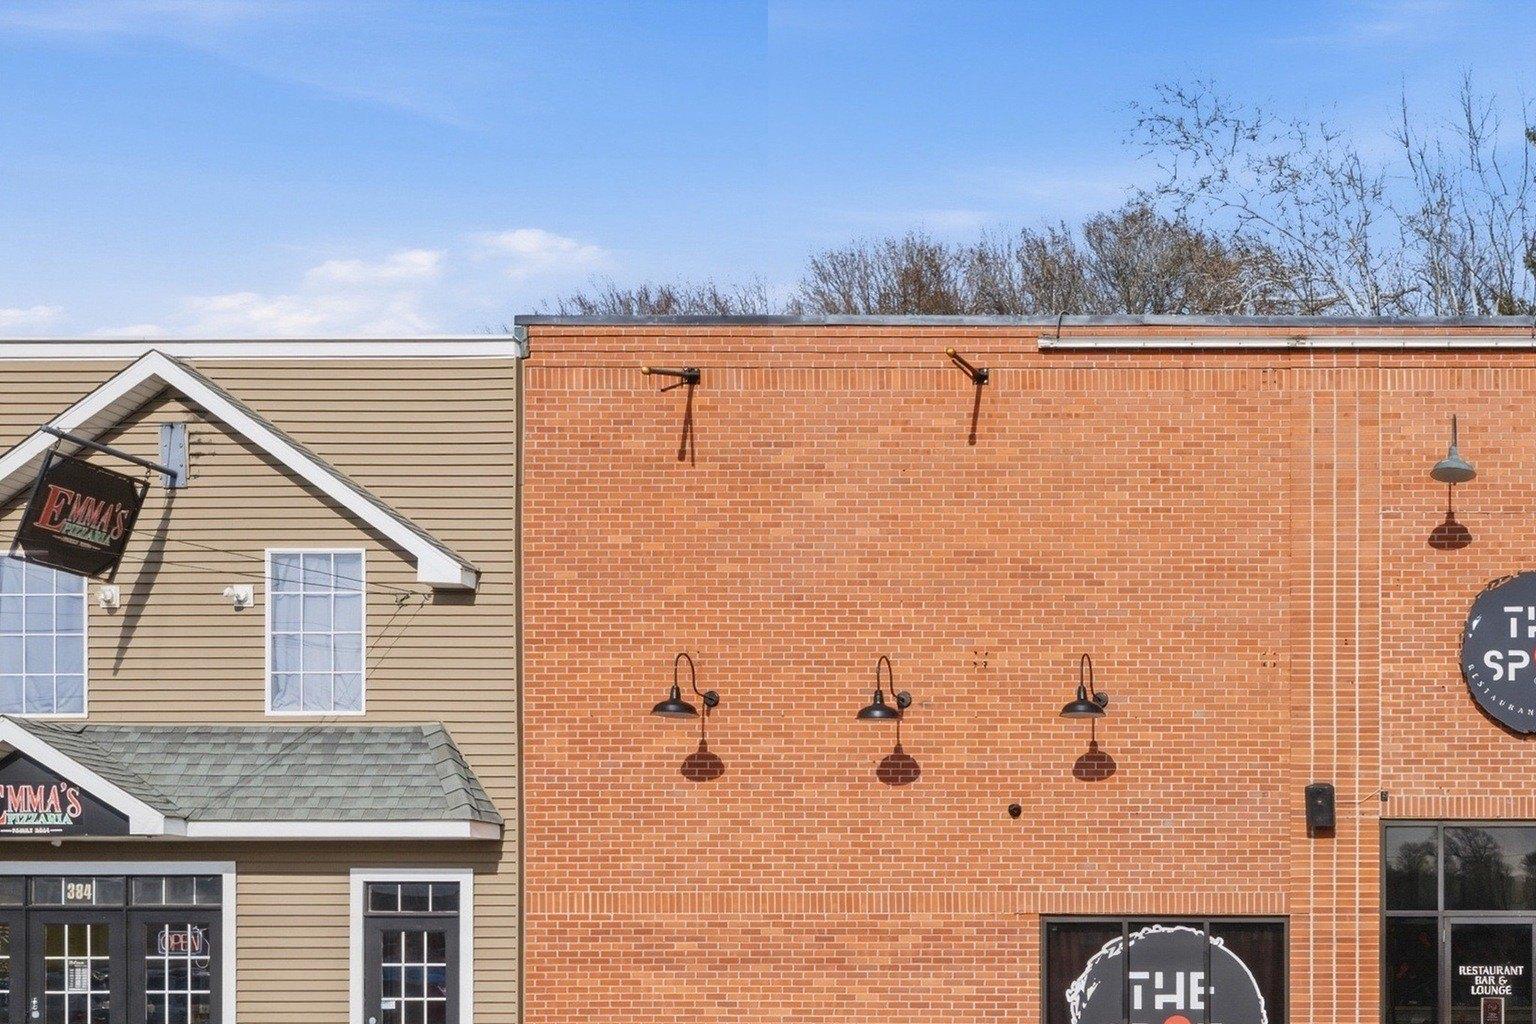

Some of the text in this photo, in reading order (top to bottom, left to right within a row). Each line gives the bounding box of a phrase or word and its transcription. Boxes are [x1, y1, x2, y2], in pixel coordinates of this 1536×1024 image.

[33, 484, 129, 540] EMMA'S
[0, 782, 82, 825] MMA'S
[66, 882, 92, 900] 384
[1458, 965, 1524, 976] RESTAURANT
[1474, 976, 1508, 985] BAR &
[1128, 971, 1215, 1010] THE
[1470, 985, 1512, 995] LOUNGE
